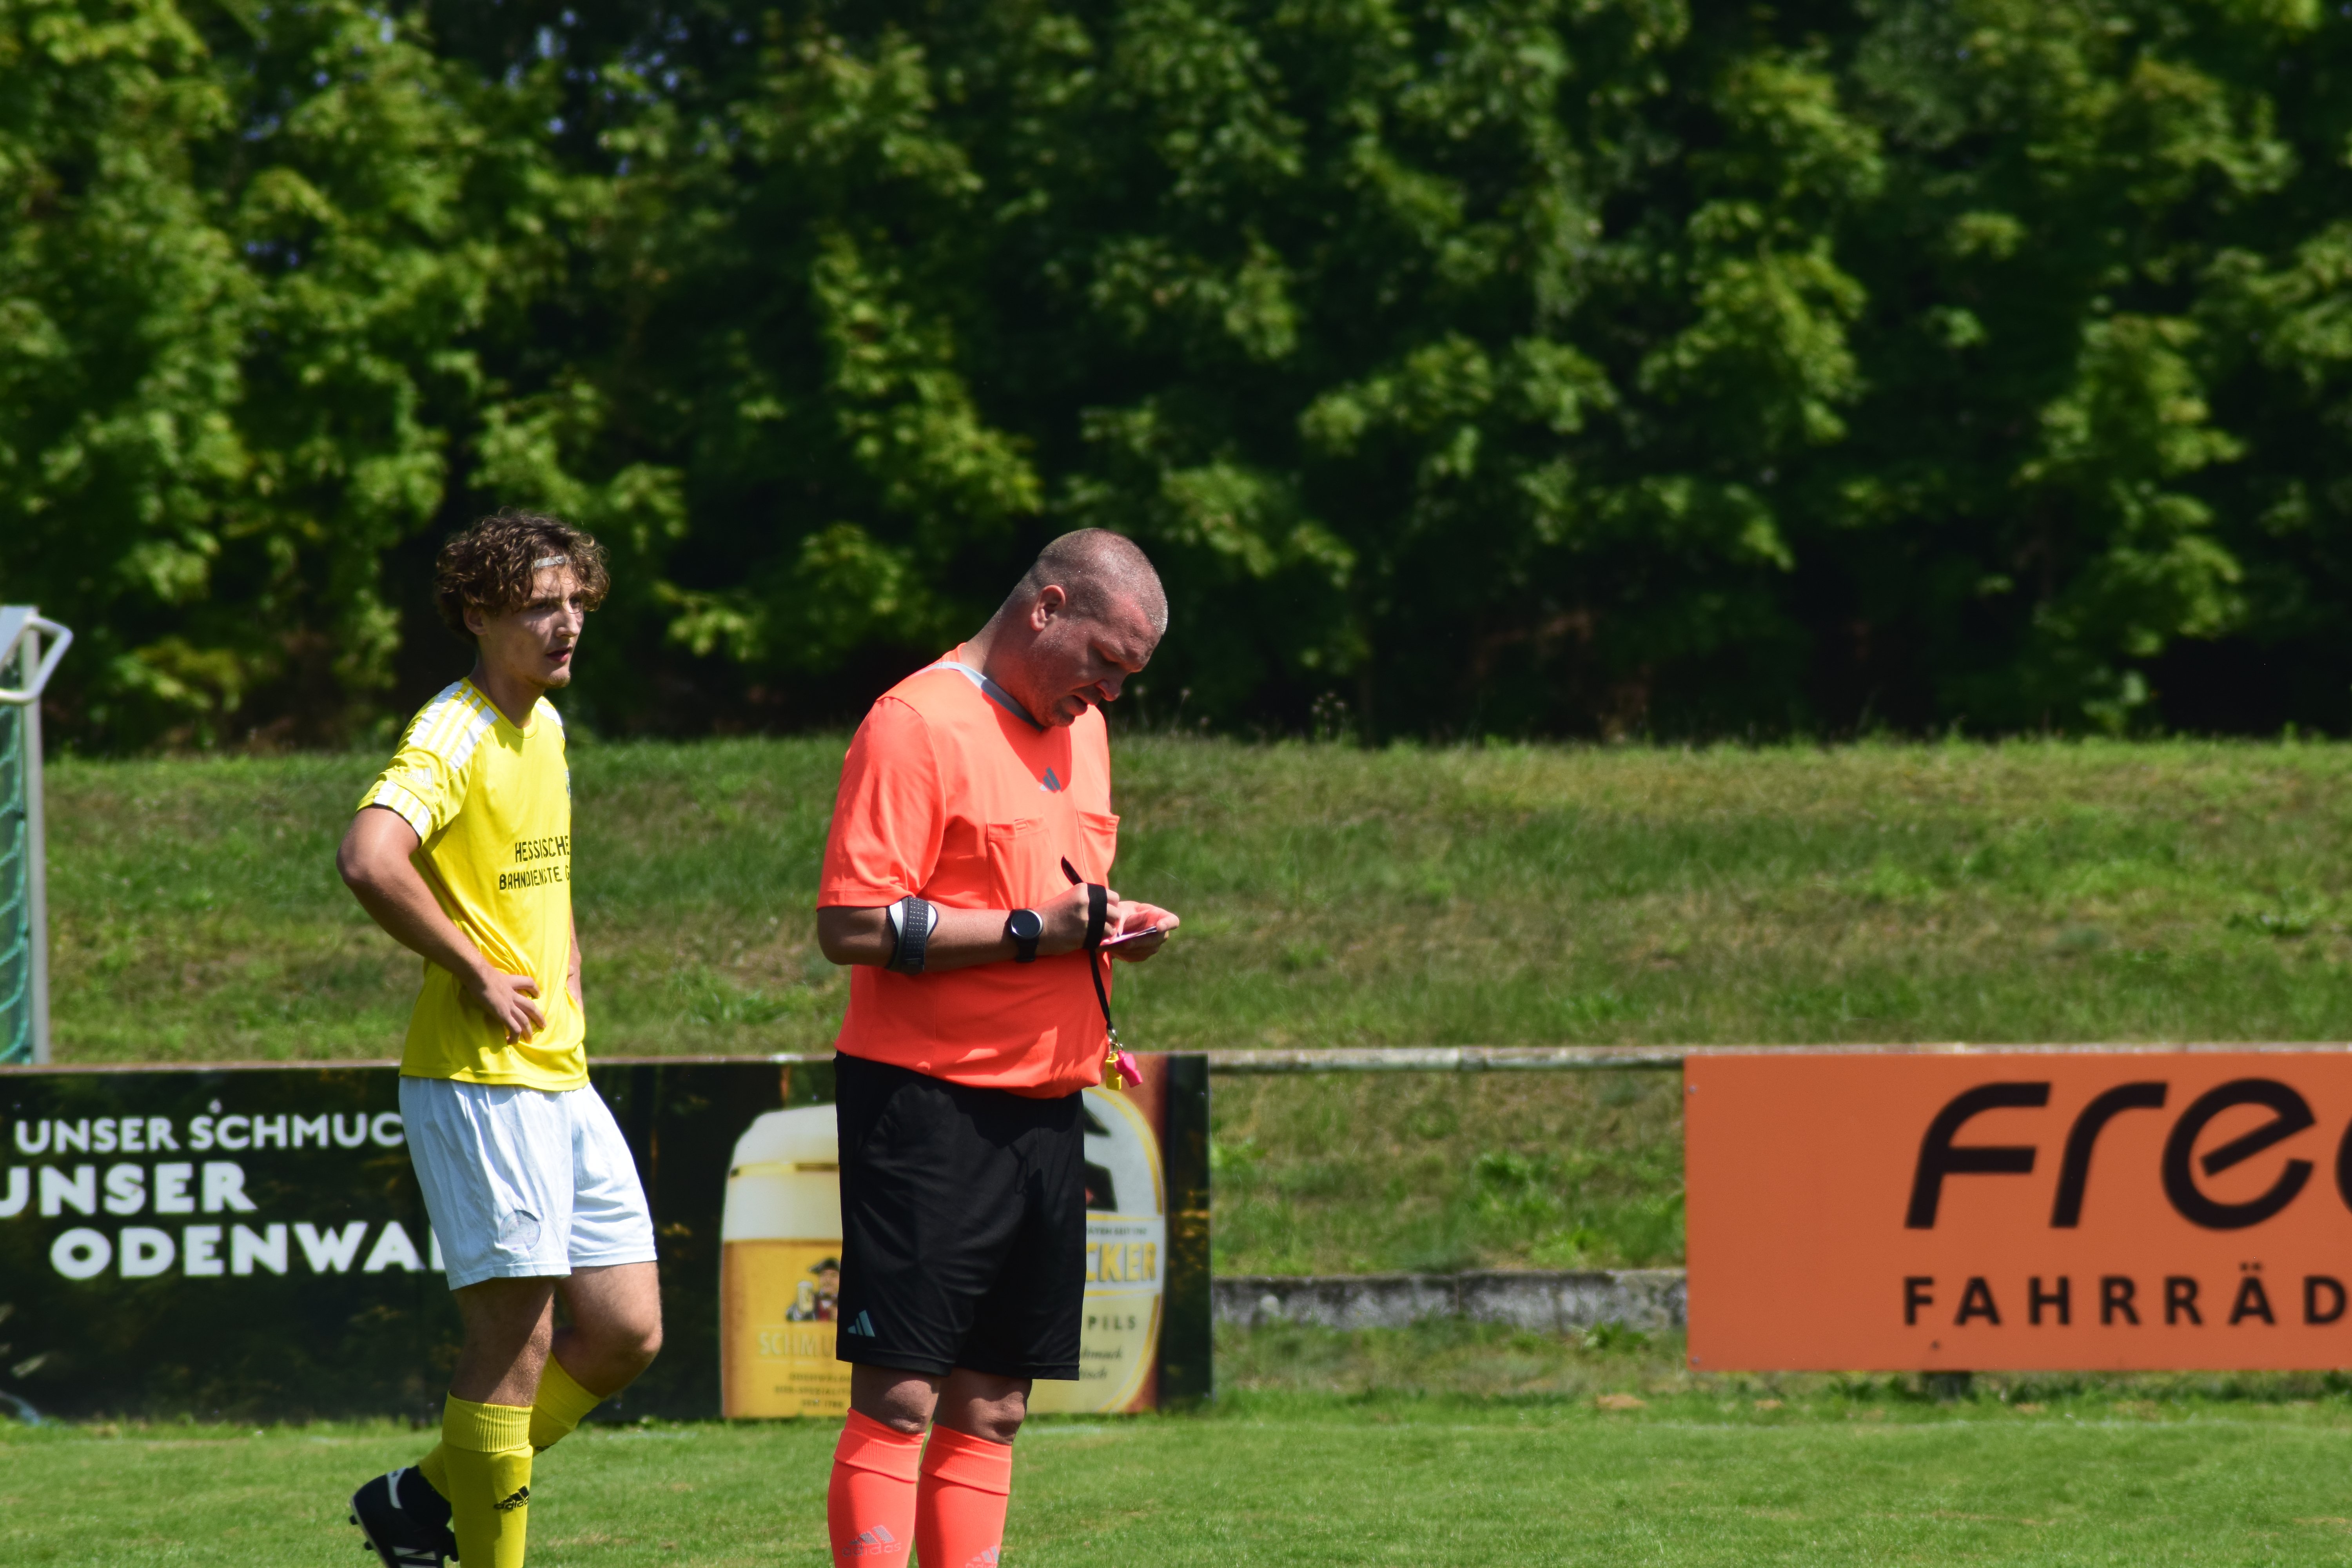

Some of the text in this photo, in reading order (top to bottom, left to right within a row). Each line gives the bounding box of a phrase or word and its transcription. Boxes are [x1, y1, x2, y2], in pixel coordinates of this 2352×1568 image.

[515, 835, 570, 862] HESSISCHE
[499, 866, 563, 890] BAHNDIENSTE
[14, 1117, 180, 1155] UNSER
[1902, 1261, 2347, 1326] FAHRRÄD
[1087, 1315, 1136, 1330] PILS
[842, 1543, 901, 1557] adidas
